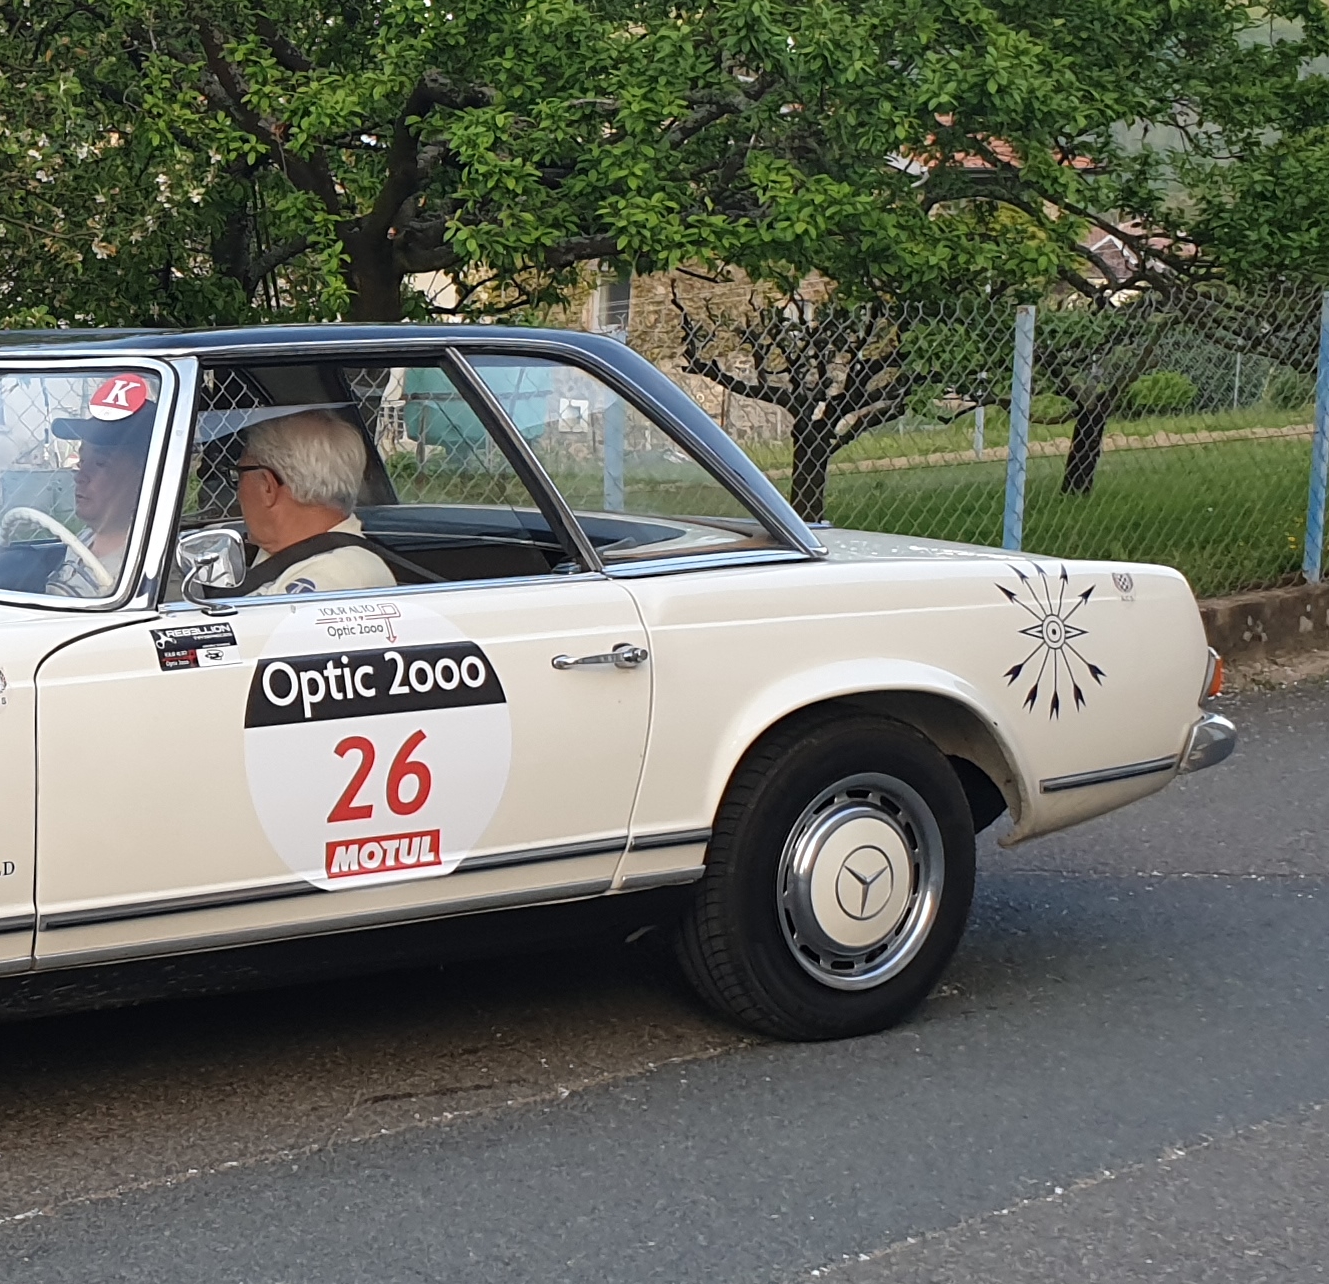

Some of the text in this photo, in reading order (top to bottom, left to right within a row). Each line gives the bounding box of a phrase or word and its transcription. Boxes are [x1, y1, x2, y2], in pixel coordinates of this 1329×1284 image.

[102, 379, 141, 407] K
[327, 623, 384, 640] Optic 2000
[262, 650, 486, 719] Optic 2000
[327, 728, 432, 824] 26
[330, 835, 435, 874] MOTUL
